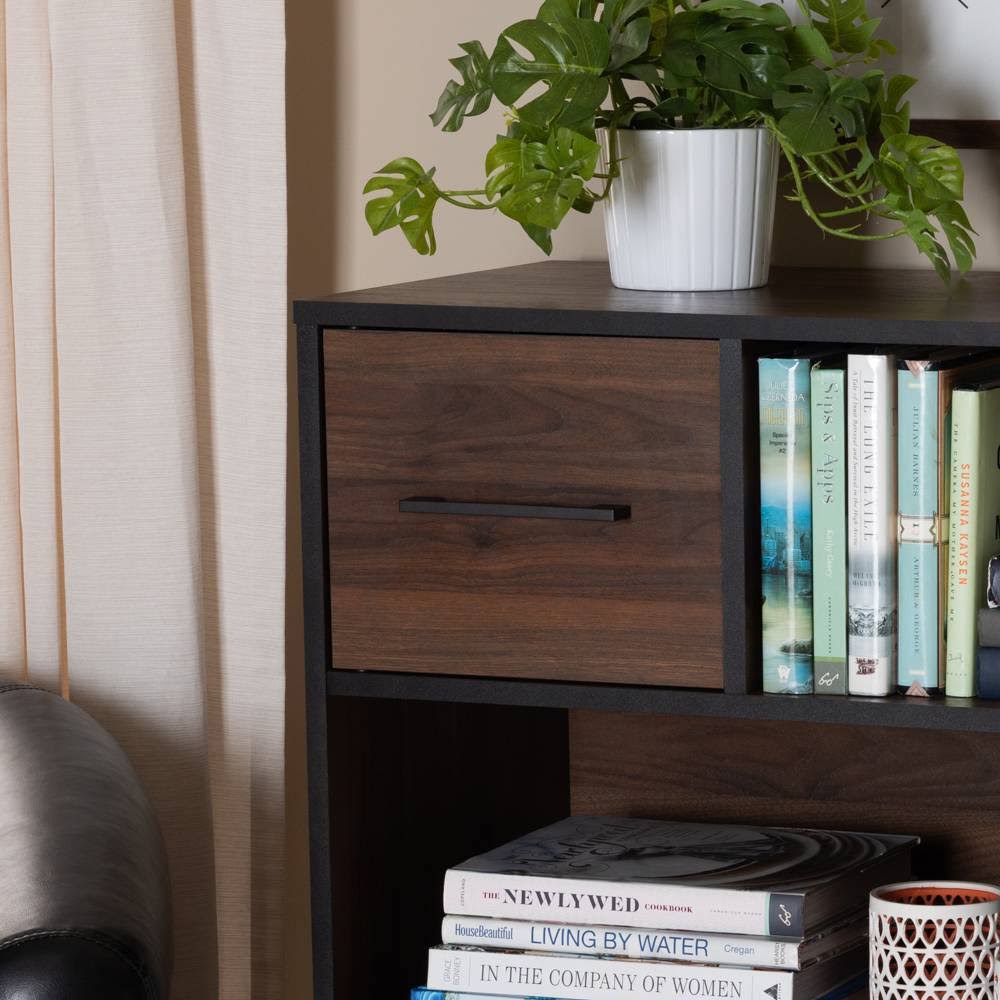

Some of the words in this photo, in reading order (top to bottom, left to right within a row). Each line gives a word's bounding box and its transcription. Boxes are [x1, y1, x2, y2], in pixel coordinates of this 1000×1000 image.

[816, 382, 839, 425] Sips
[912, 405, 920, 449] JULIAN
[816, 453, 839, 505] Apps
[912, 453, 920, 497] BARNES
[959, 462, 971, 527] SUSANNA
[958, 532, 970, 586] KAYSEN
[482, 890, 500, 900] THE
[503, 888, 640, 913] NEWLYWED
[644, 903, 694, 914] COOKBOOK
[454, 923, 514, 941] HouseBeautiful
[530, 926, 597, 949] LIVING
[603, 931, 632, 951] BY
[638, 933, 709, 958] WATER
[723, 944, 756, 957] Cregan
[443, 959, 452, 984] GRACE
[452, 956, 463, 986] BONNEY
[480, 963, 499, 983] IN
[505, 965, 543, 986] THE
[549, 967, 638, 993] COMPANY
[642, 975, 667, 994] OF
[672, 976, 743, 999] WOMEN
